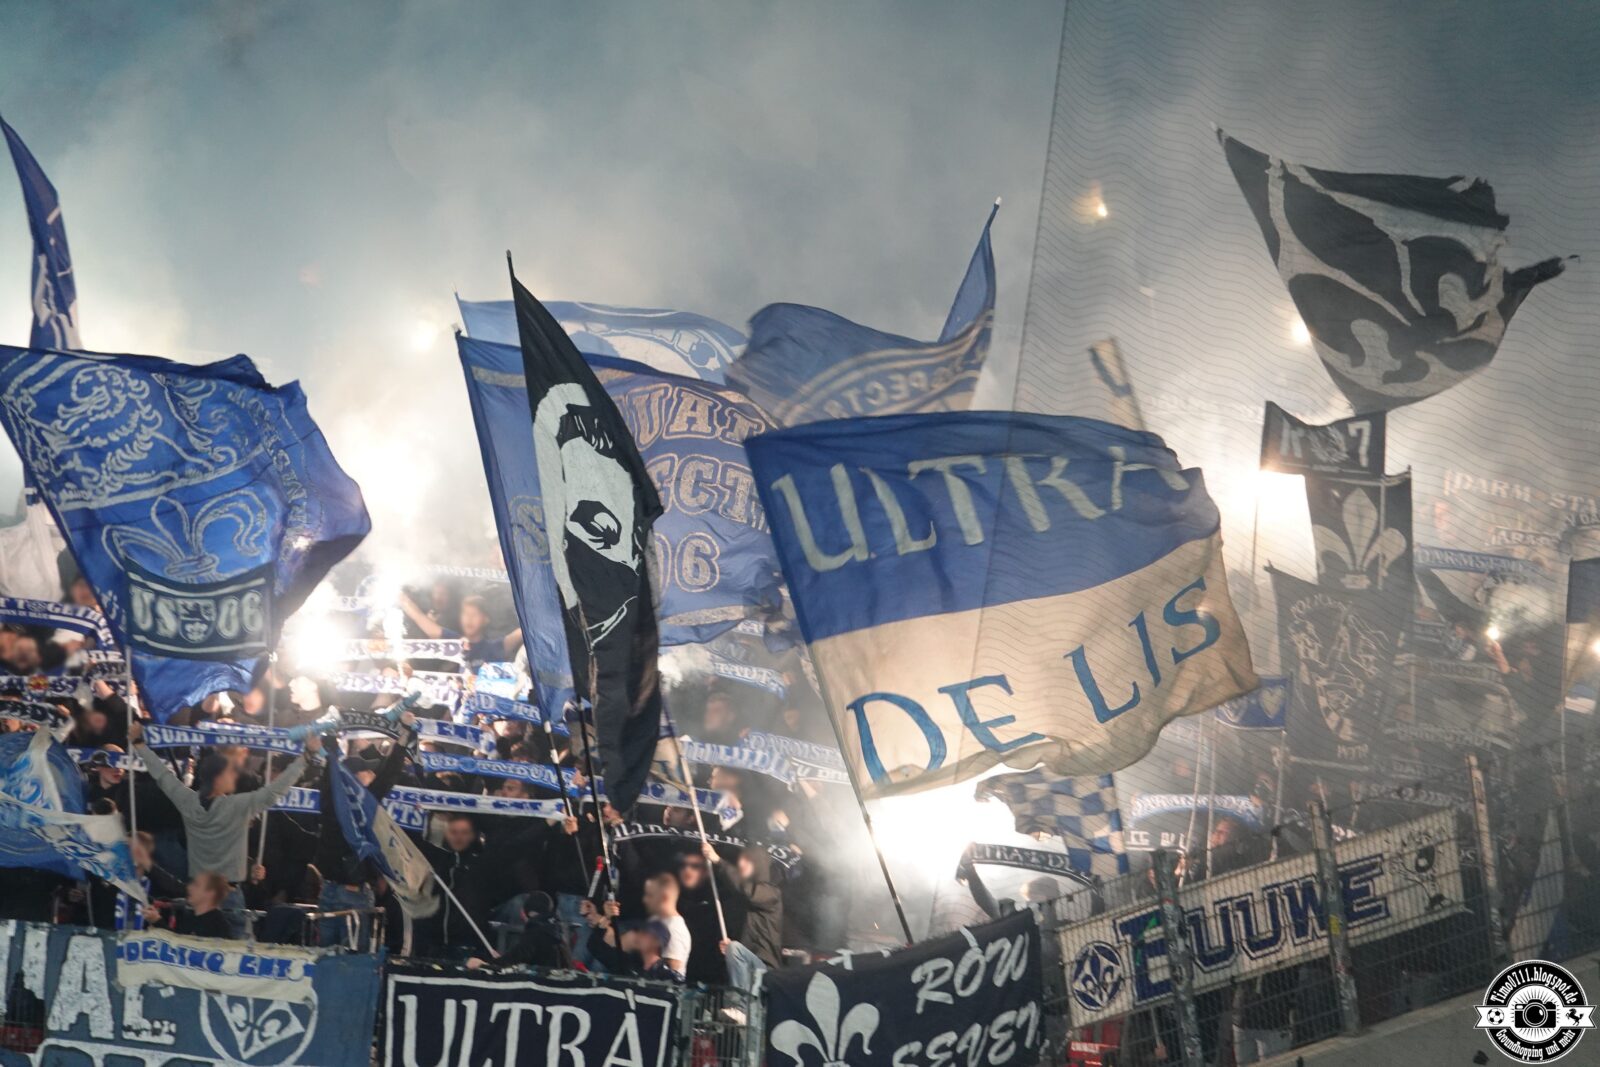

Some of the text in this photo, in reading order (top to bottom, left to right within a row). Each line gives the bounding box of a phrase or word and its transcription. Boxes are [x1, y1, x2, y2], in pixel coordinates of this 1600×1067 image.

[846, 576, 1221, 785] DE LIS
[911, 930, 1030, 1014] ROW
